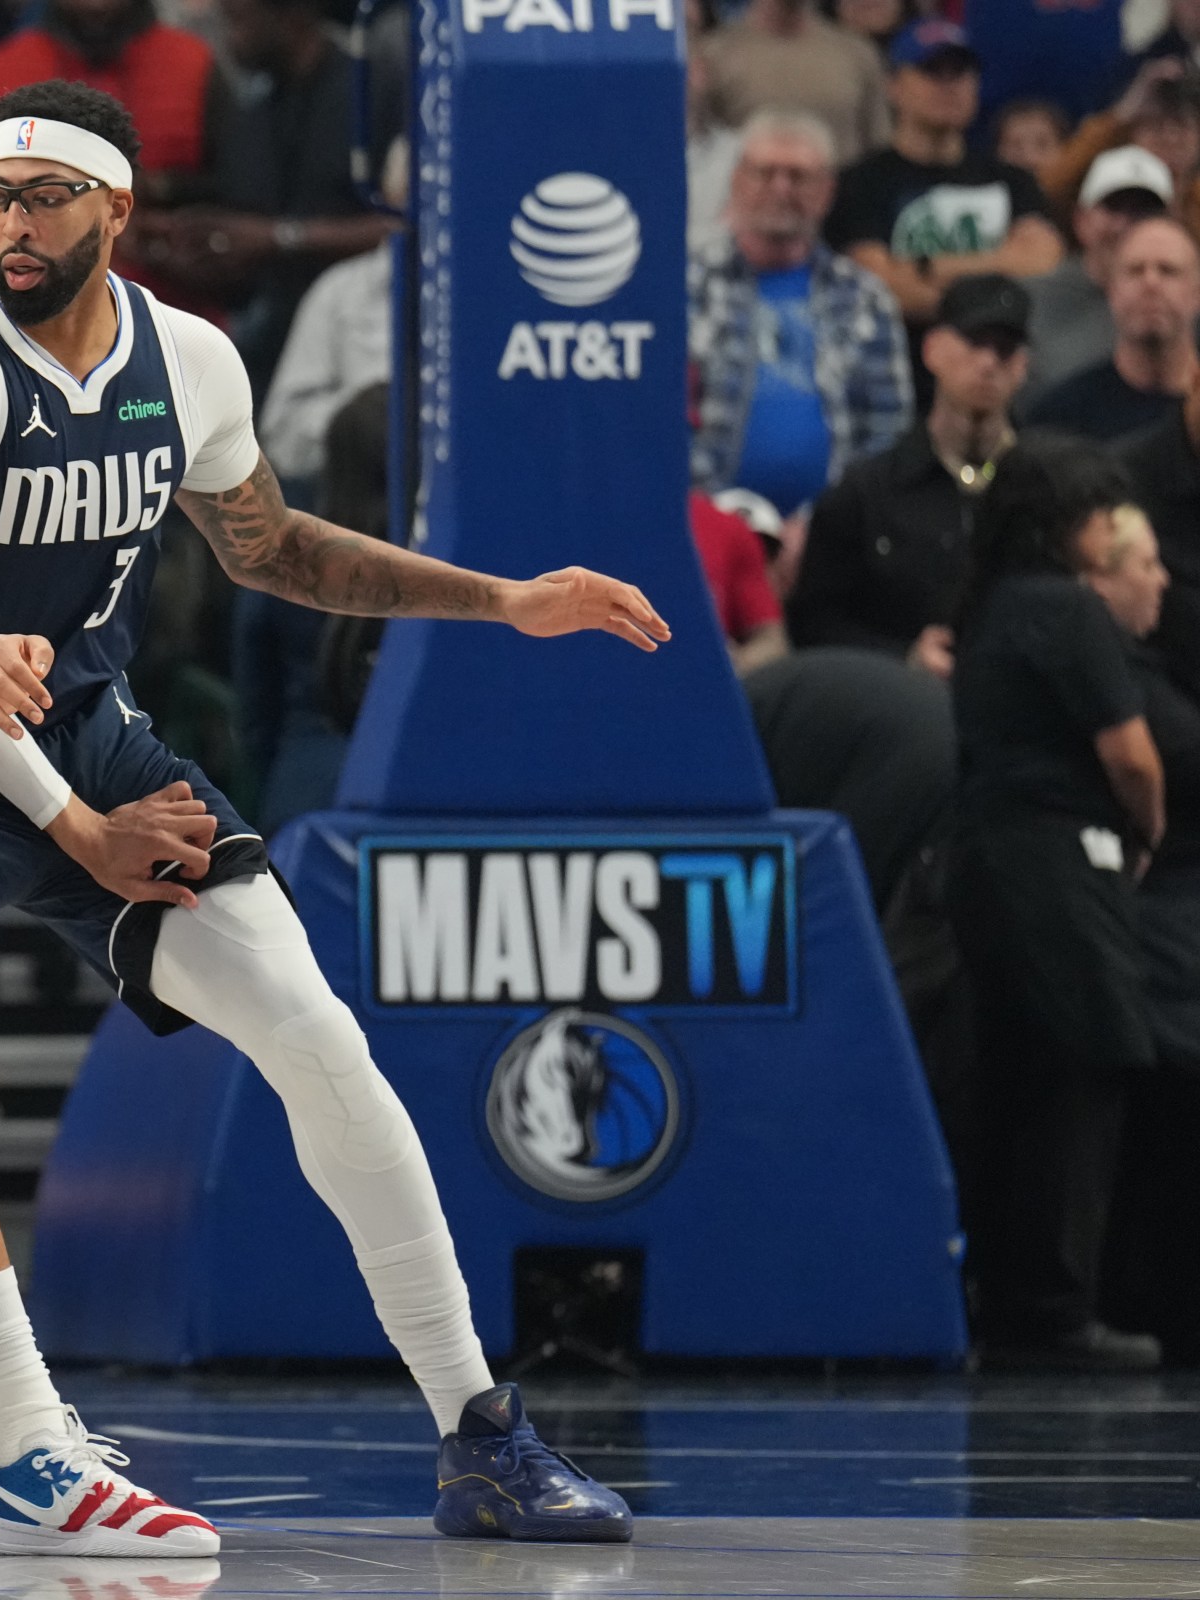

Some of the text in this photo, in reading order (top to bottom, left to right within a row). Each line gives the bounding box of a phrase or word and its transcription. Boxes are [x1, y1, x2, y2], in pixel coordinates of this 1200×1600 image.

[497, 320, 656, 380] AT&T
[118, 399, 167, 421] chime
[83, 546, 141, 629] 3
